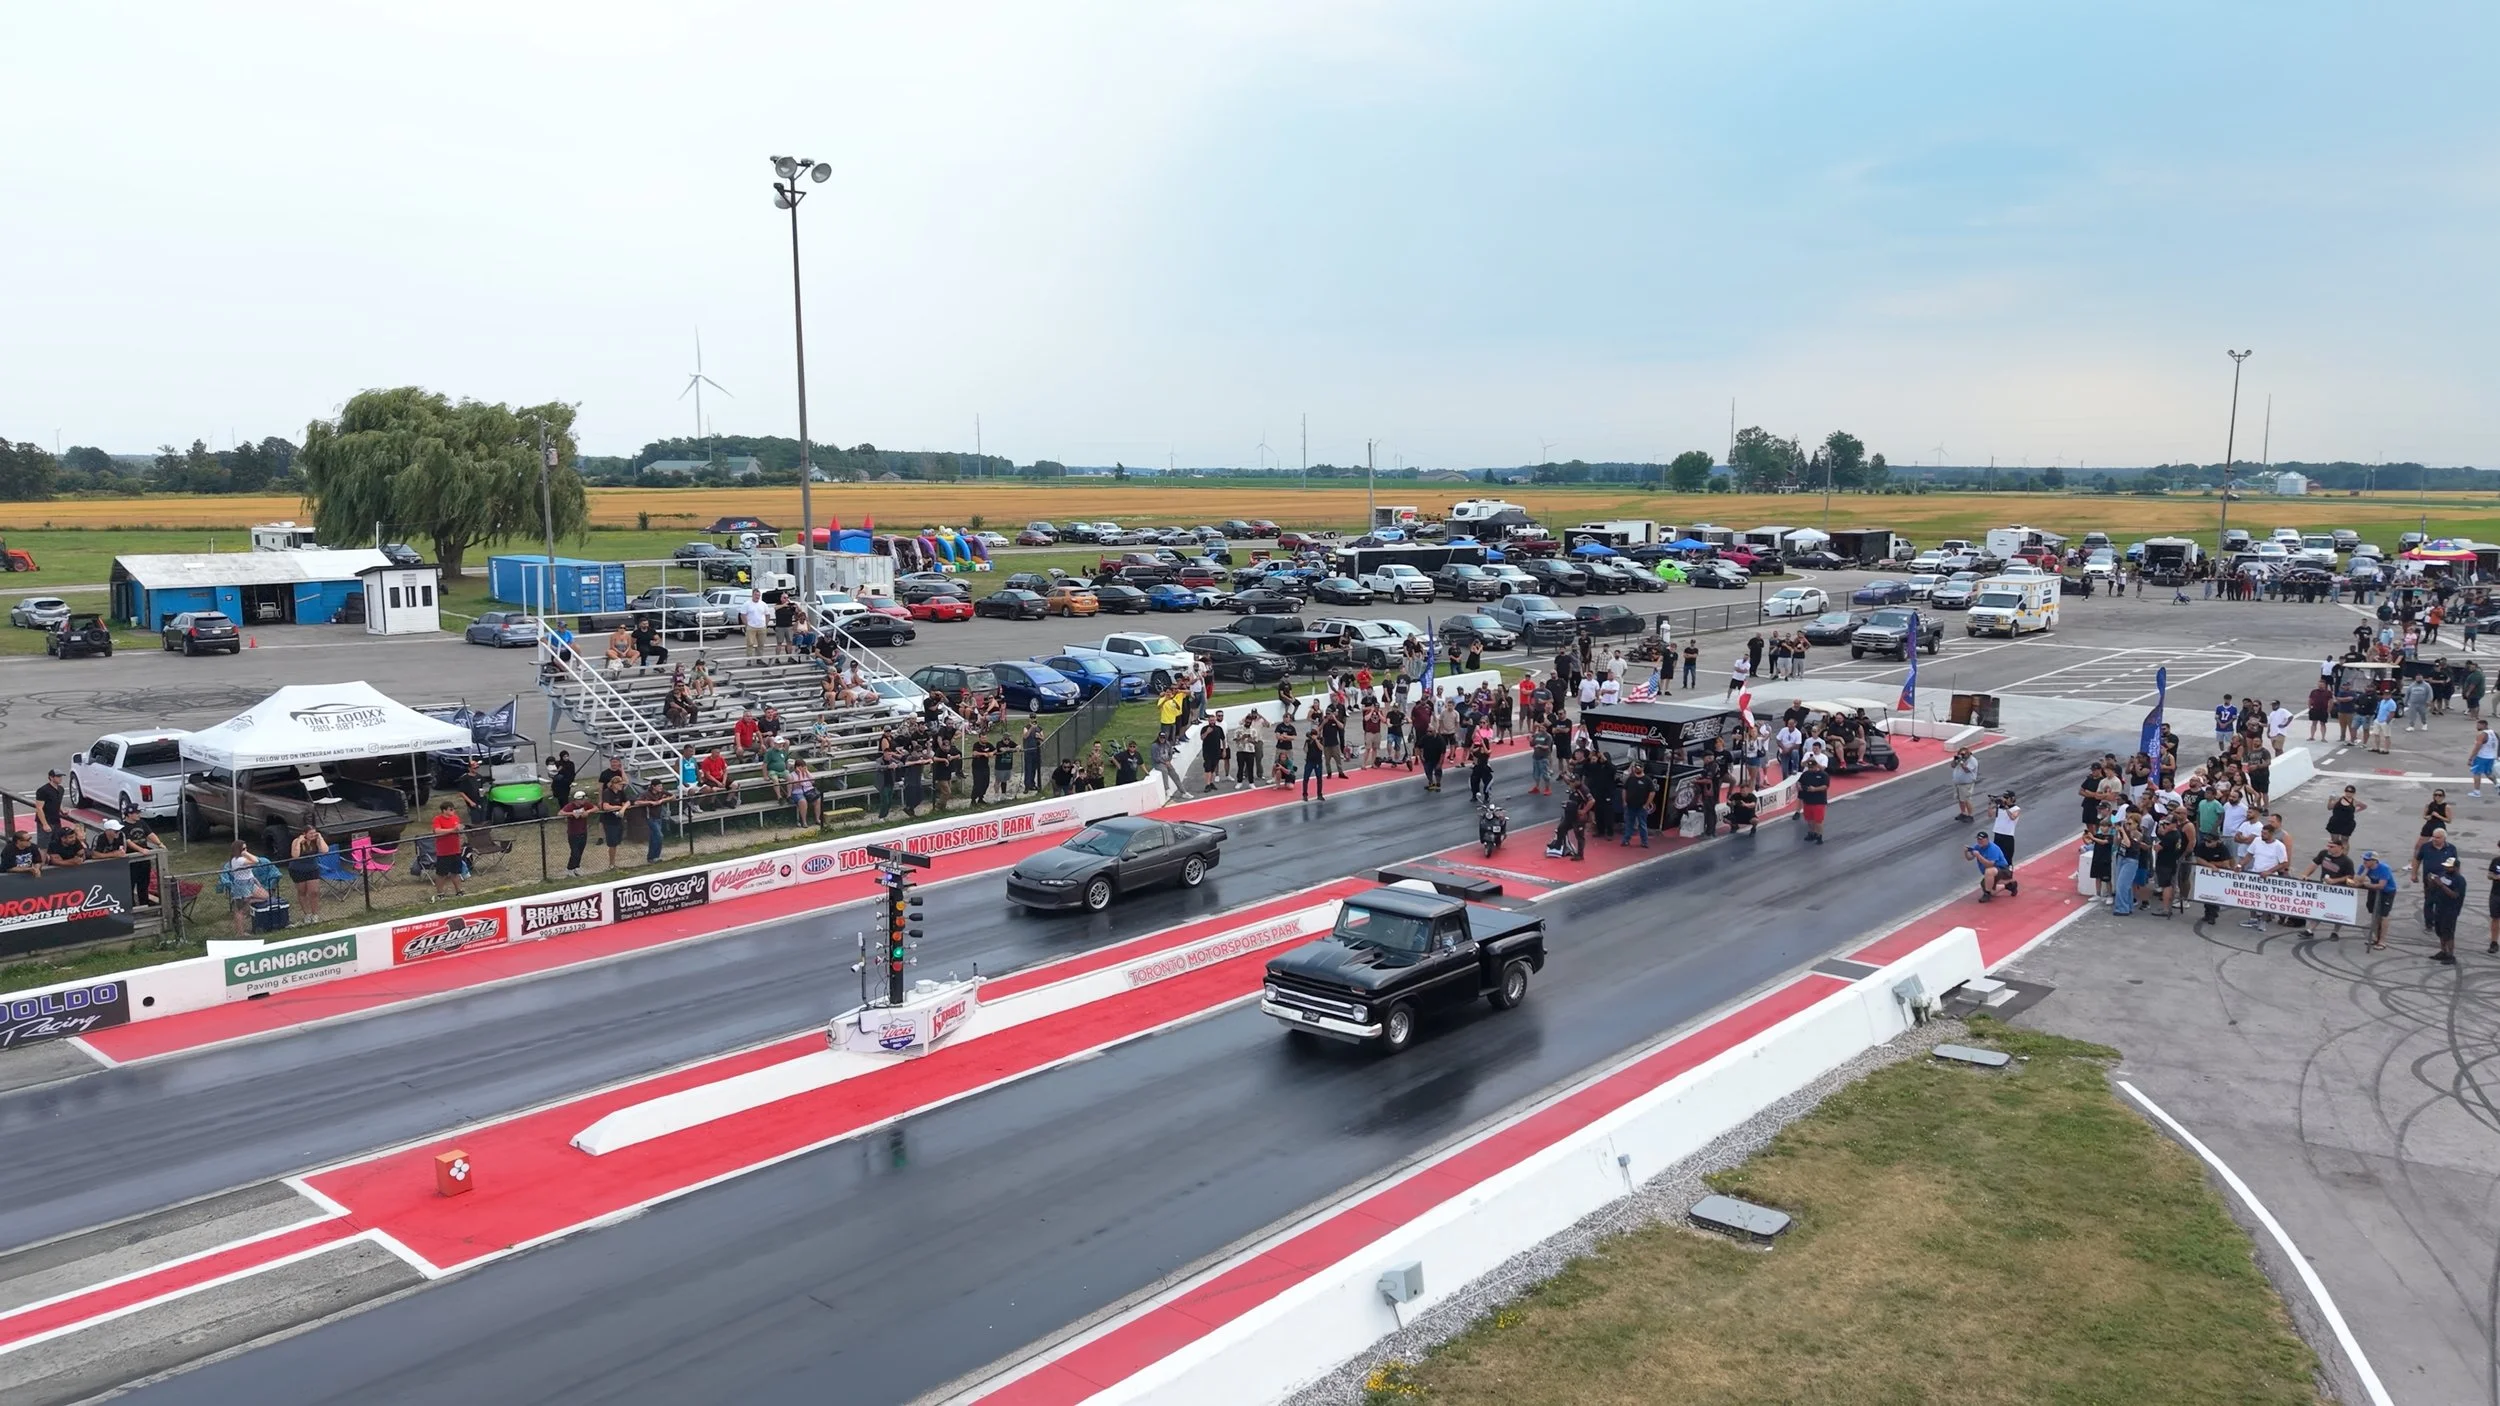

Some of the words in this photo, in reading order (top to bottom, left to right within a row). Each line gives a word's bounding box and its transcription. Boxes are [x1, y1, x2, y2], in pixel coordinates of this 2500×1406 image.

[301, 714, 331, 727] TINT
[336, 708, 386, 724] ADDIXX
[2221, 711, 2230, 721] 17
[1601, 721, 1648, 735] TORONTO
[255, 755, 280, 763] FOLLOW
[299, 749, 332, 760] INSTAGRAM
[333, 748, 345, 756] AND
[345, 746, 365, 754] TIKTOK
[1042, 809, 1070, 820] TORONTO
[839, 840, 903, 870] TORO
[907, 822, 999, 856] MOTORSPORTS
[1003, 814, 1034, 837] PARK
[805, 858, 831, 872] NHRA
[712, 859, 776, 892] Oldsmobile
[881, 880, 898, 888] STAGE
[2200, 868, 2216, 877] ALL
[2219, 871, 2246, 881] CREW
[2249, 875, 2297, 889] MEMBERS
[2300, 882, 2313, 891] TO
[2316, 884, 2354, 897] REMAIN
[617, 887, 649, 908] Tim
[649, 875, 706, 901] Orser's
[2224, 888, 2261, 900] UNLESS
[2264, 894, 2290, 904] YOUR
[2293, 898, 2313, 907] CAR
[2316, 901, 2326, 909] IS
[2233, 881, 2268, 893] BEHIND
[2271, 887, 2293, 896] THIS
[2296, 890, 2318, 900] LINE
[54, 905, 82, 917] PARK
[68, 909, 110, 921] CAYUGA
[526, 896, 599, 921] BREAKAWAY
[633, 910, 645, 918] Lifts
[2237, 898, 2261, 908] NEXT
[2264, 901, 2277, 910] TO
[2279, 904, 2311, 916] STAGE
[526, 915, 559, 931] AUTO
[562, 908, 599, 921] GLASS
[404, 919, 499, 953] CALEDONIA
[233, 941, 350, 978] GLANBROOK
[1129, 956, 1187, 985] TORONTO
[1187, 930, 1270, 966] MOTORSPORTS
[1271, 920, 1300, 940] PARK
[246, 979, 279, 992] Paving
[281, 975, 289, 984] &
[291, 966, 342, 983] Excavating
[883, 1026, 914, 1038] LUCAS
